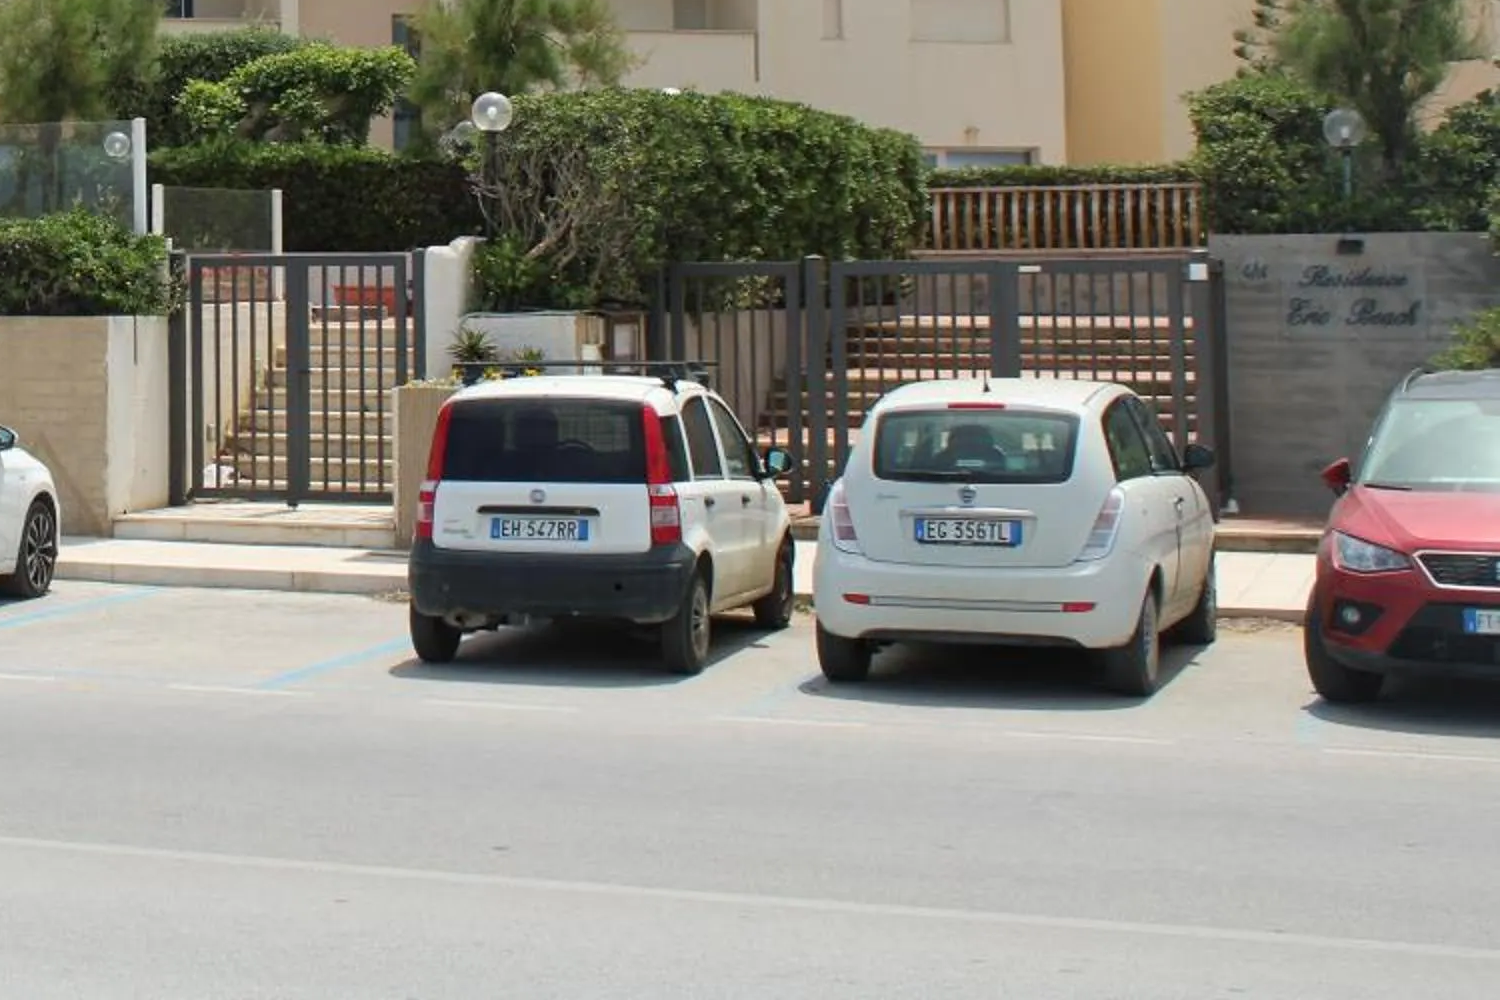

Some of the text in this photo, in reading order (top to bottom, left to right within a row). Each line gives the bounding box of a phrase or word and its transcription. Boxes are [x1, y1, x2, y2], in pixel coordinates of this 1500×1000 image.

[501, 520, 577, 537] EH 547RR
[926, 521, 948, 539] EG
